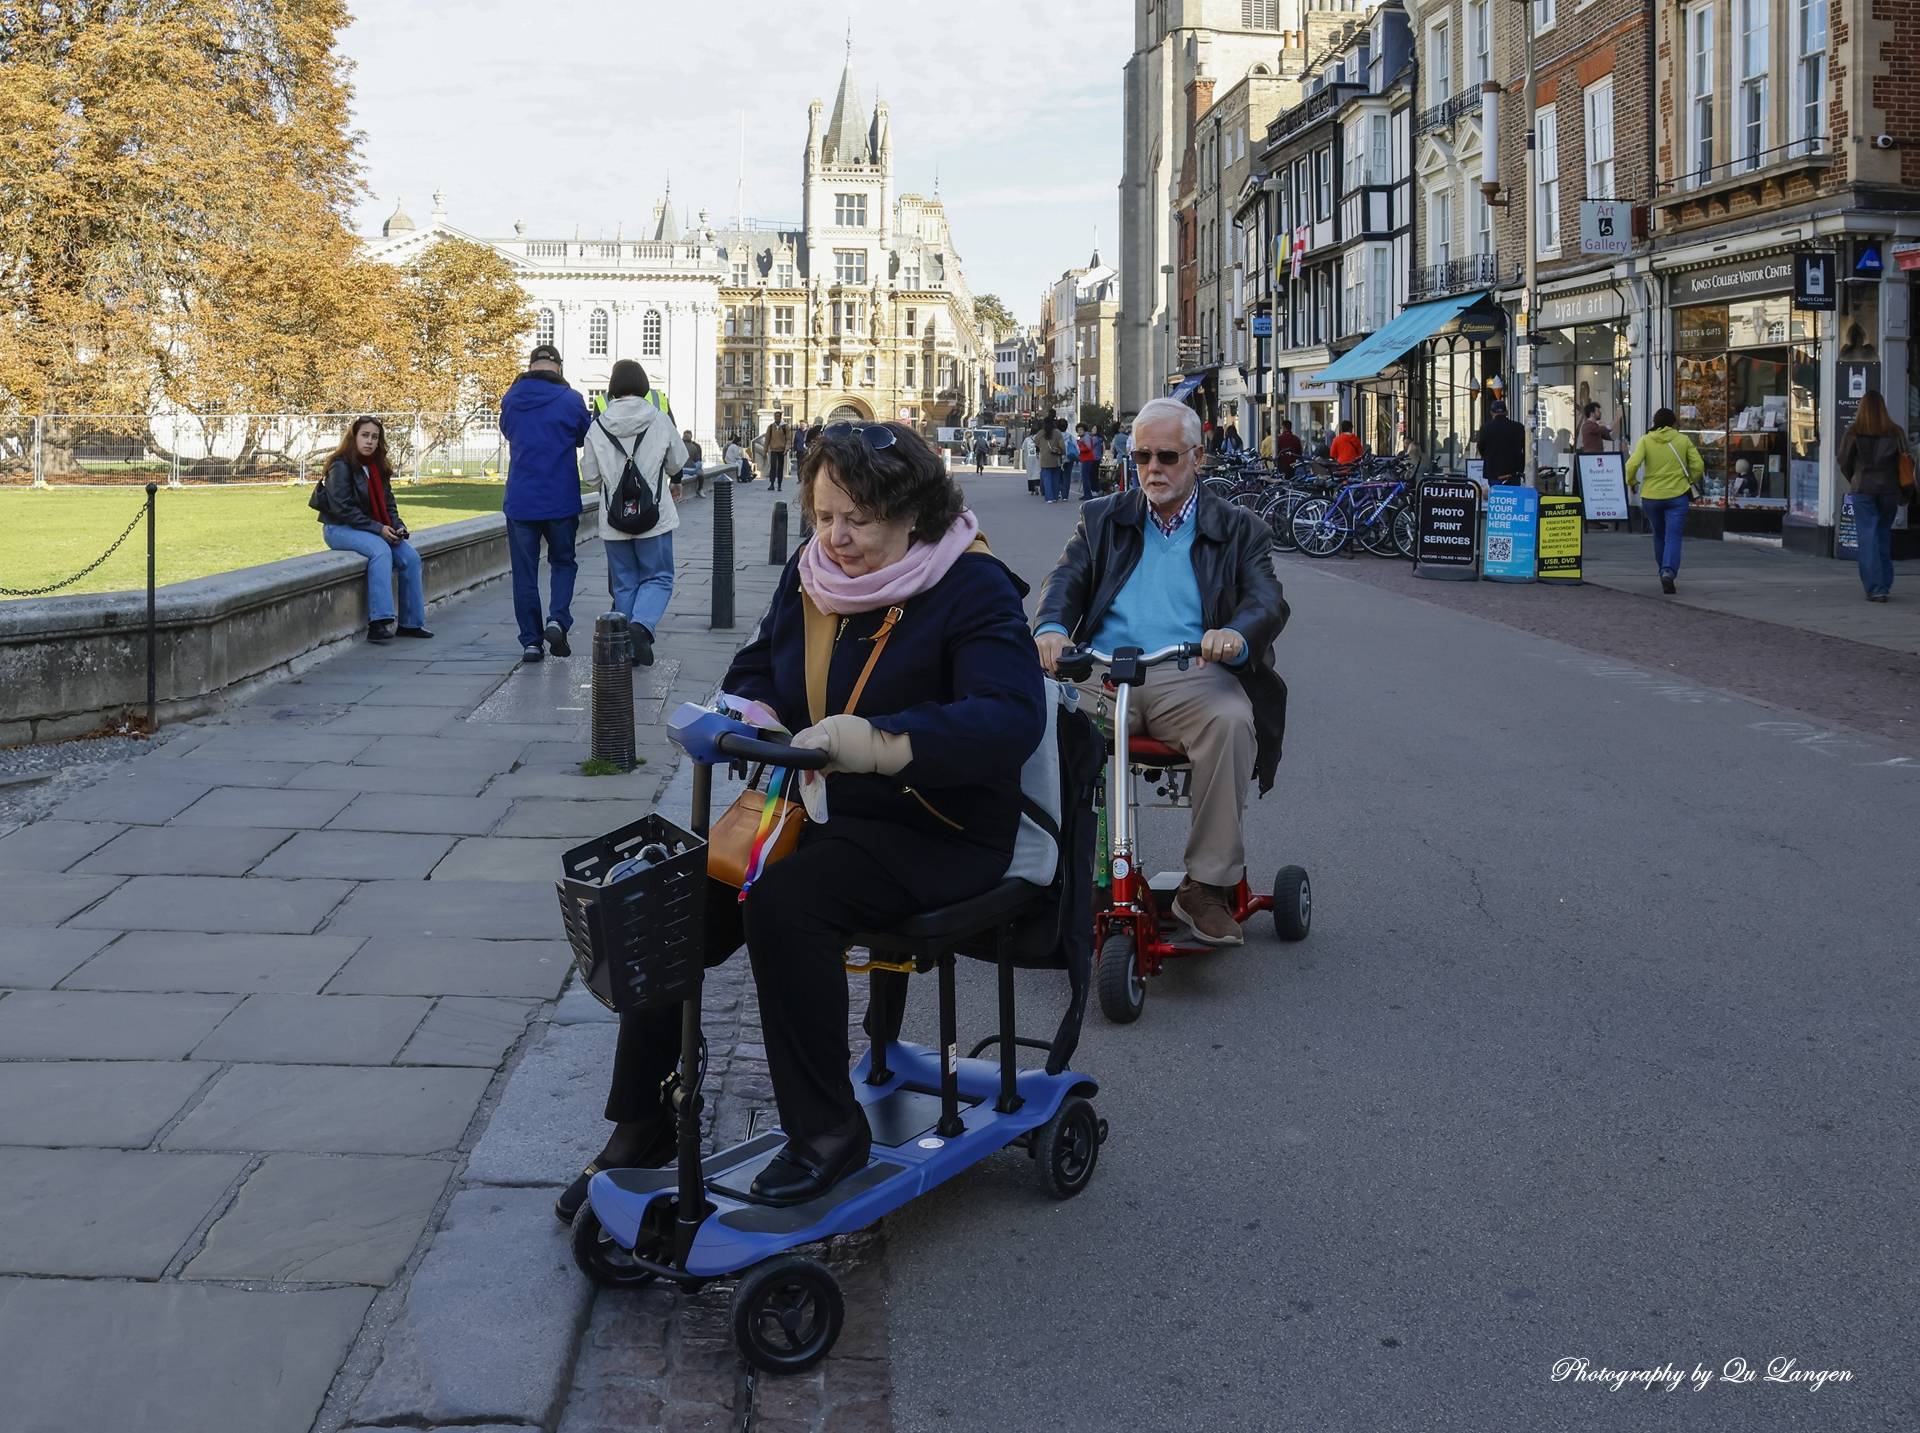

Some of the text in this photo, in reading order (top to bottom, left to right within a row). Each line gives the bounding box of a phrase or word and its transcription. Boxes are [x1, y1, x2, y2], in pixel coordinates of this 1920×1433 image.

[1597, 206, 1614, 217] Art
[1585, 239, 1627, 251] Gallery
[1555, 297, 1603, 322] byard art
[1680, 329, 1700, 337] TICKETS
[1706, 328, 1721, 336] GIFTS
[1490, 497, 1518, 505] STORE
[1432, 508, 1464, 517] PHOTO
[1490, 505, 1513, 513] YOUR
[1489, 513, 1530, 522] LUGGAGE
[1433, 522, 1462, 531] PRINT
[1488, 521, 1511, 529] HERE
[1424, 535, 1470, 545] SERVICES
